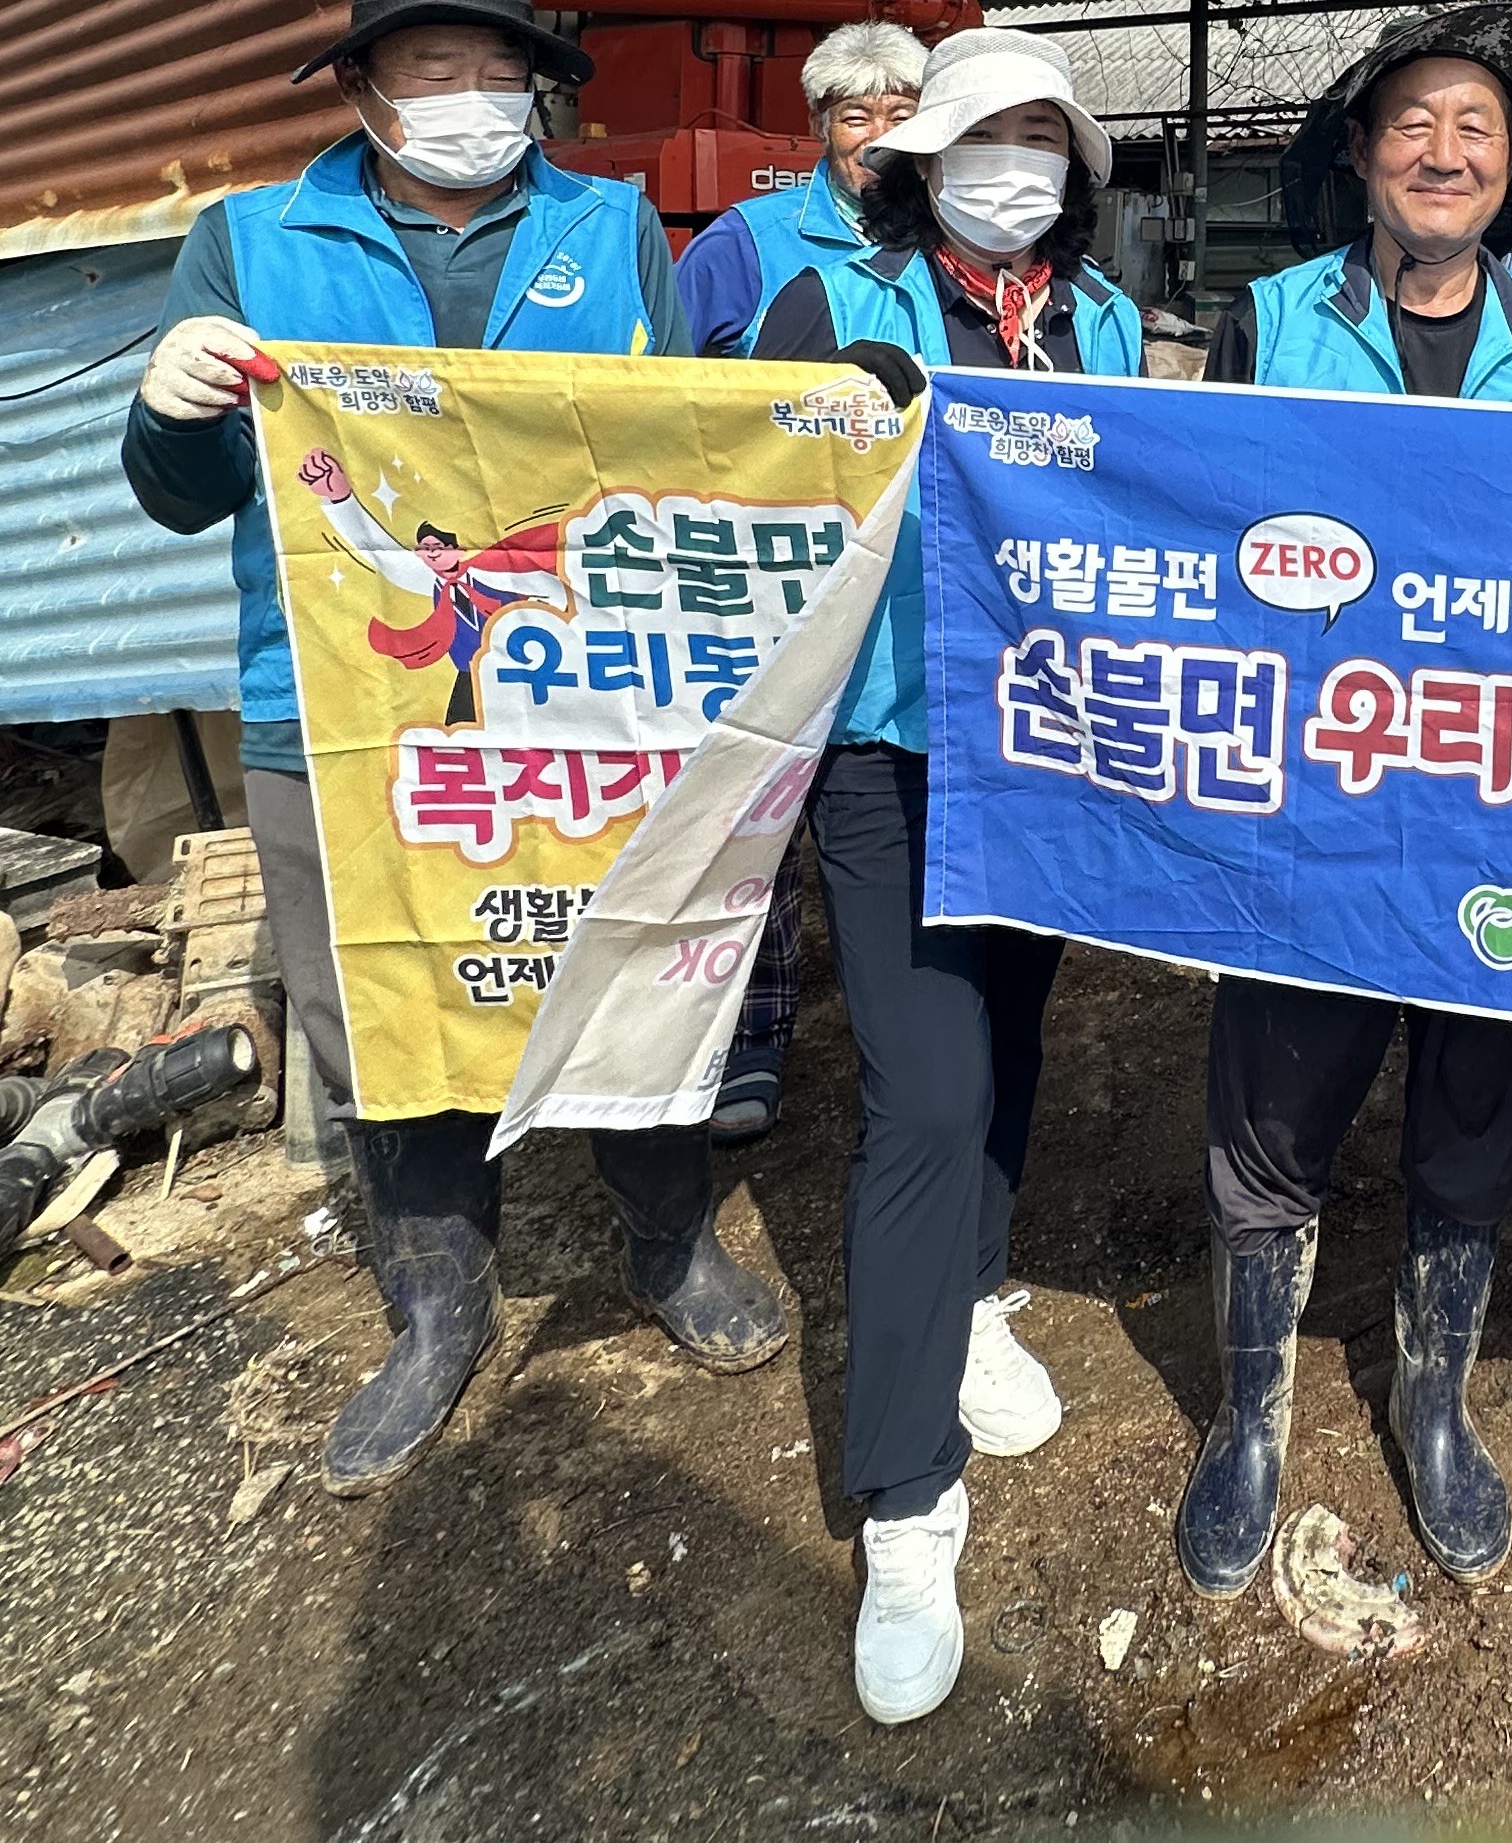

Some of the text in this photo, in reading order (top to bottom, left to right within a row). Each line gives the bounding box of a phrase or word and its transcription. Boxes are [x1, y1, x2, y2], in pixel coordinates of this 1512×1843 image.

[290, 364, 391, 388] 새로운 도약
[403, 393, 440, 416] 함평
[812, 393, 890, 417] 우리동네
[772, 402, 901, 451] 복지기동대
[948, 405, 1047, 438] 새로운 도약
[1056, 444, 1091, 469] 함평
[994, 537, 1219, 621] 생활불편
[1249, 541, 1361, 581] ZERO
[497, 624, 782, 724] 우리동
[1004, 635, 1280, 807] 손불면
